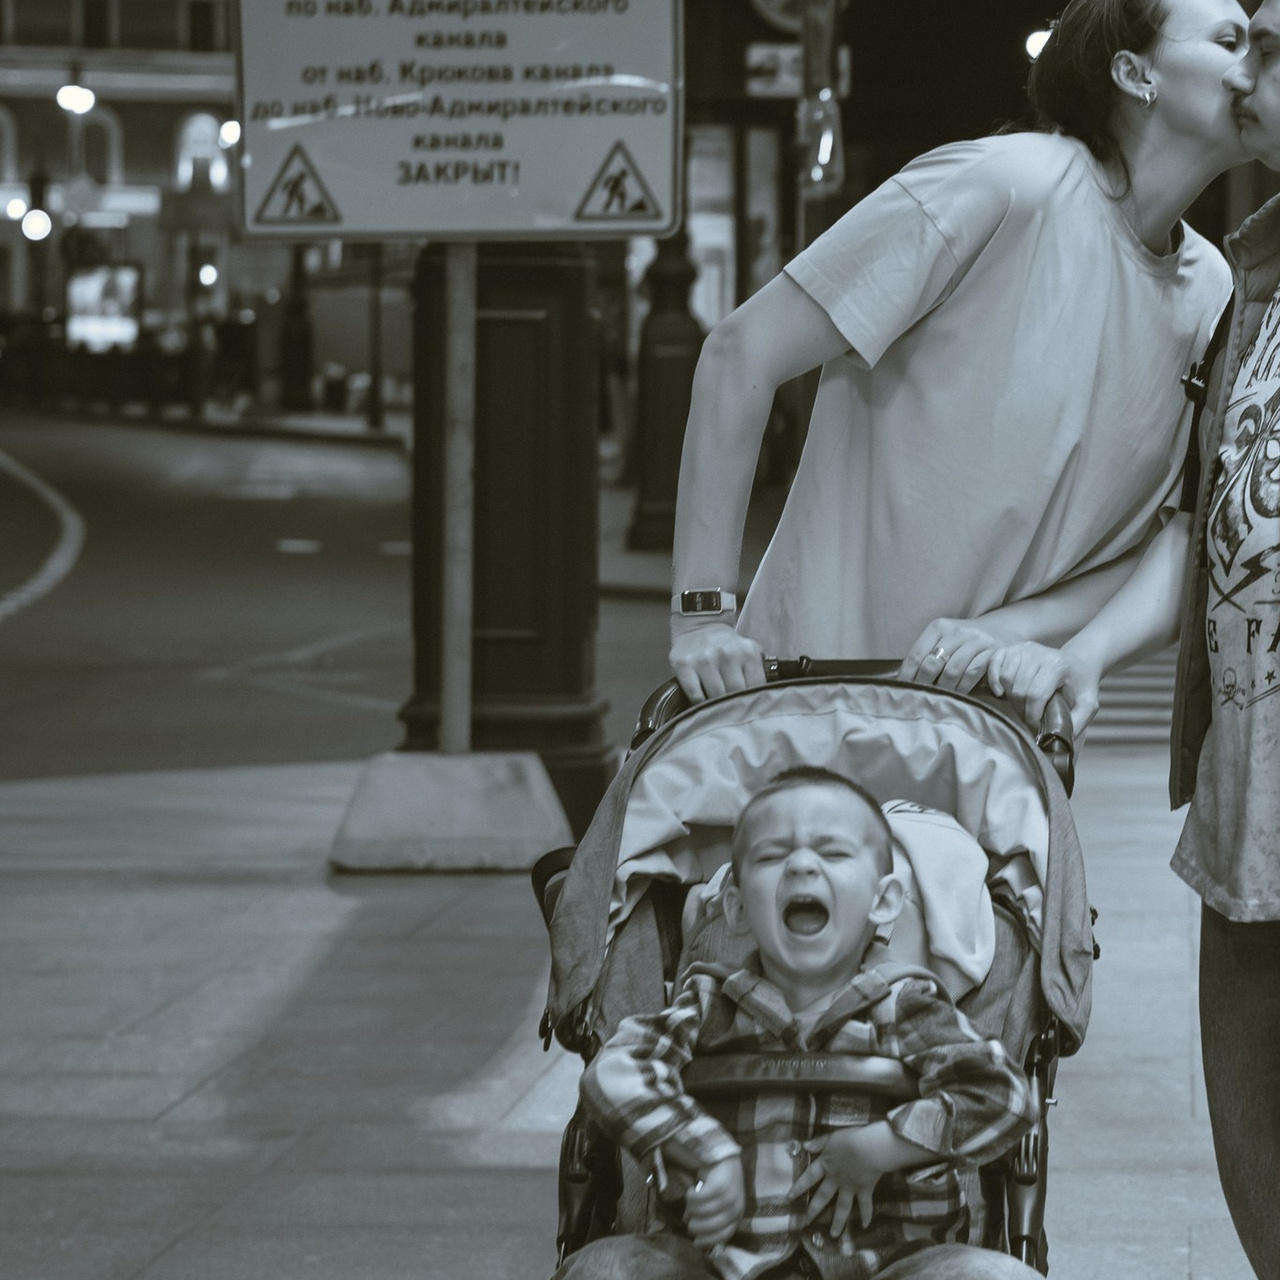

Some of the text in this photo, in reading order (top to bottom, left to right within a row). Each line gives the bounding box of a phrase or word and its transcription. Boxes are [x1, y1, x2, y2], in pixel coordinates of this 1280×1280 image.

[415, 31, 507, 51] канала
[302, 59, 615, 91] от наб. Крюкова канала
[291, 94, 346, 120] наб
[412, 132, 504, 152] канала
[398, 159, 520, 186] ЗАКРЫТ!
